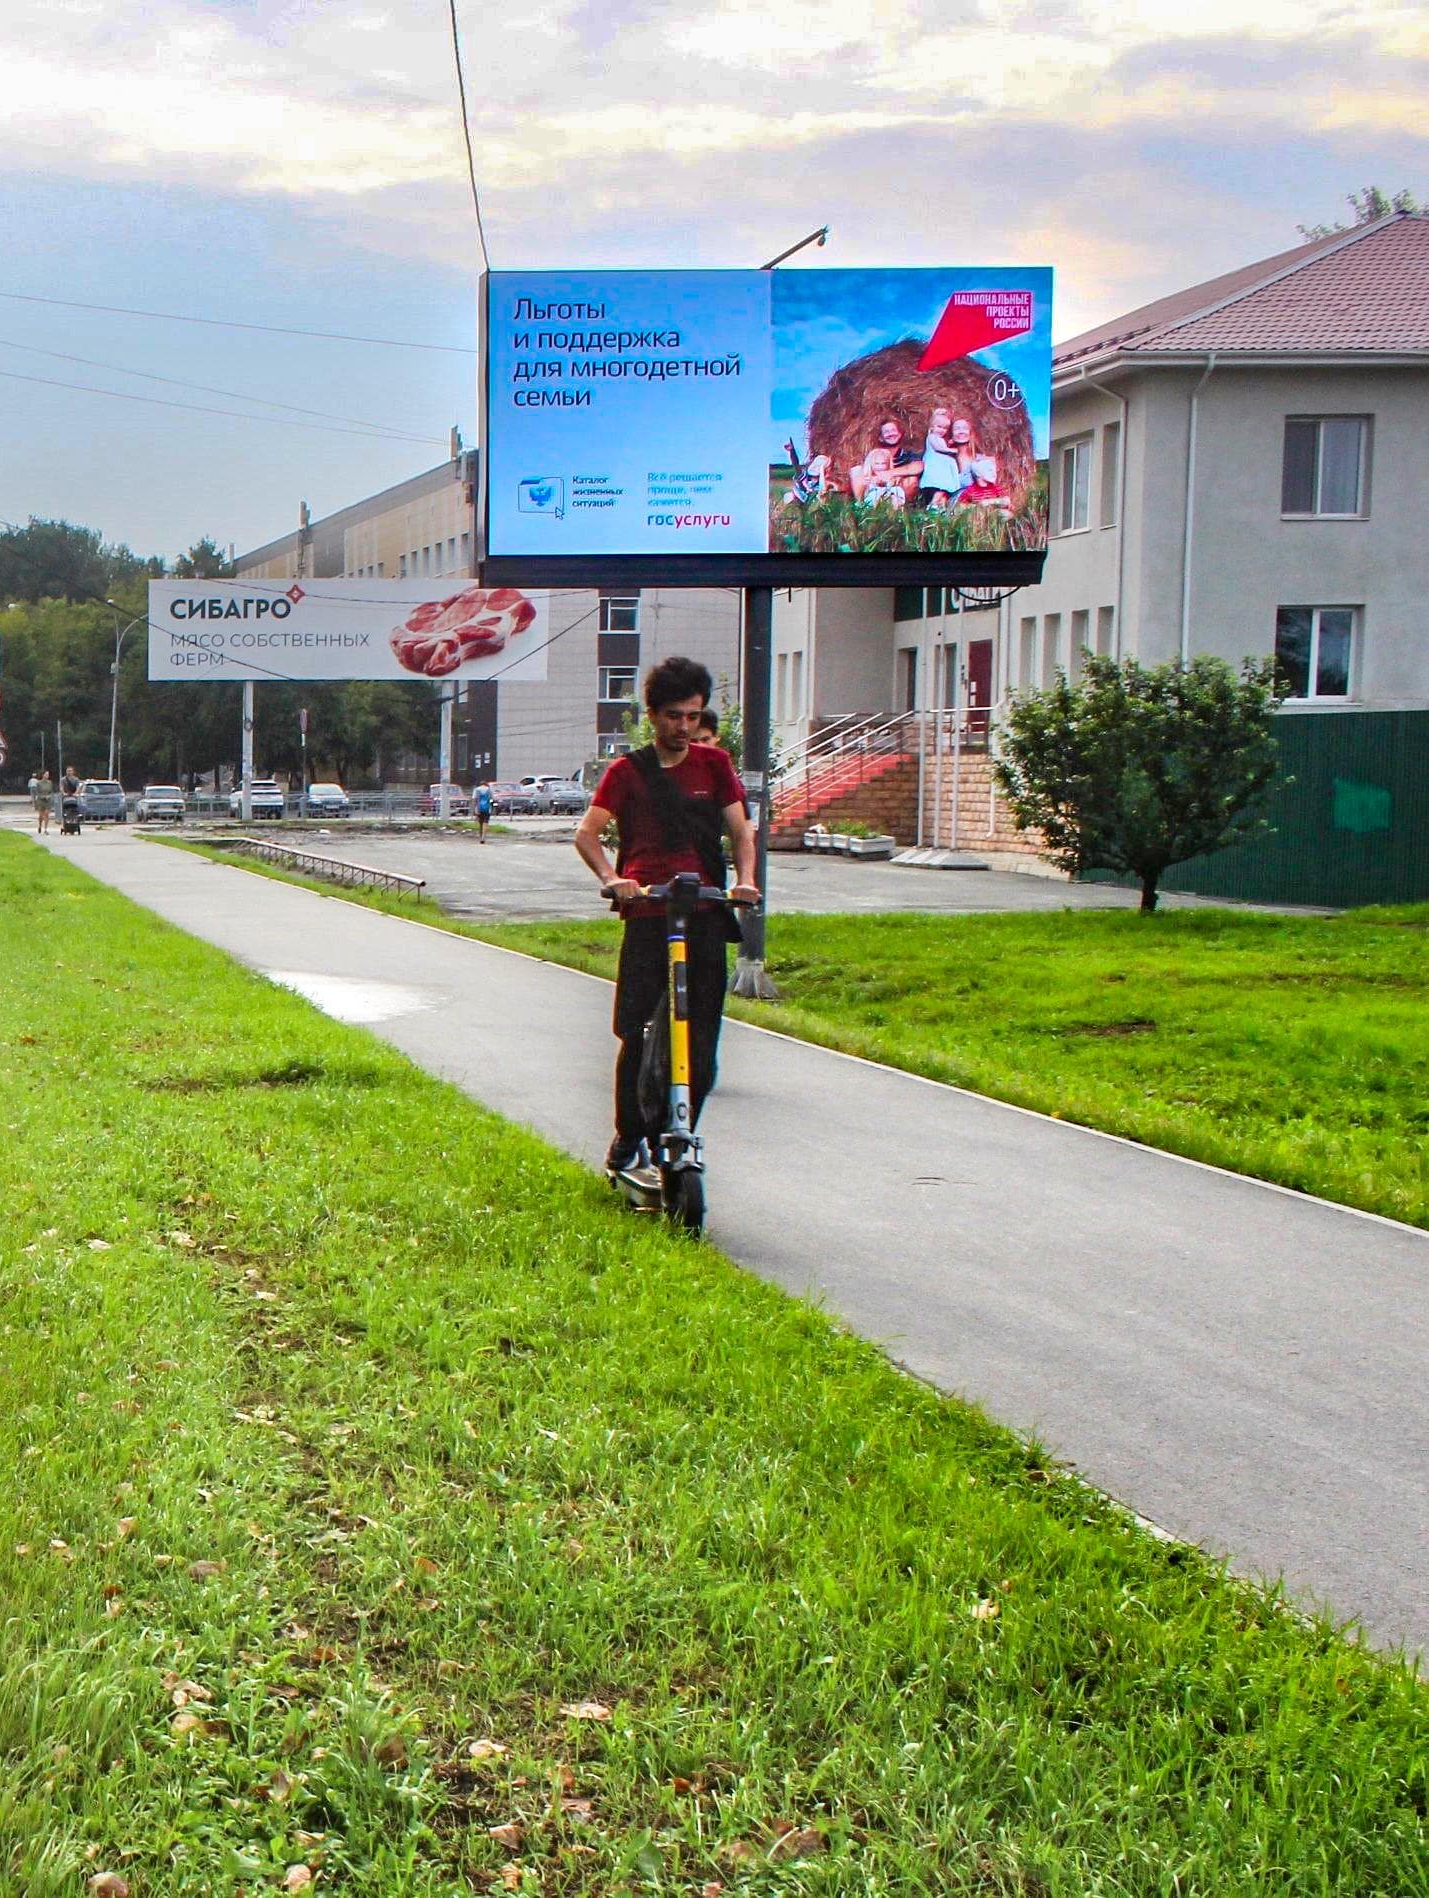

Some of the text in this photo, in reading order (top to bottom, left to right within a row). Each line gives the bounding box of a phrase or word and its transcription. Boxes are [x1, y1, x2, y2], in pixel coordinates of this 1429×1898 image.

[954, 294, 1029, 305] НАЦИОНАЛЬНЫЕ
[513, 298, 606, 320] Льготы
[986, 305, 1030, 317] ПРОЕКТЫ
[993, 317, 1030, 329] РОССИИ
[513, 330, 680, 353] и поддержка
[513, 352, 741, 382] для многодетной
[994, 379, 1020, 401] 0+
[513, 389, 591, 407] семьи
[572, 475, 609, 485] Каталог
[572, 498, 615, 508] ситуаций
[647, 514, 730, 529] госуслуги
[170, 598, 291, 620] СИБАГРО
[171, 633, 370, 648] МЯСО СОБСТВЕННЫХ
[171, 652, 224, 667] ФЕРМ
